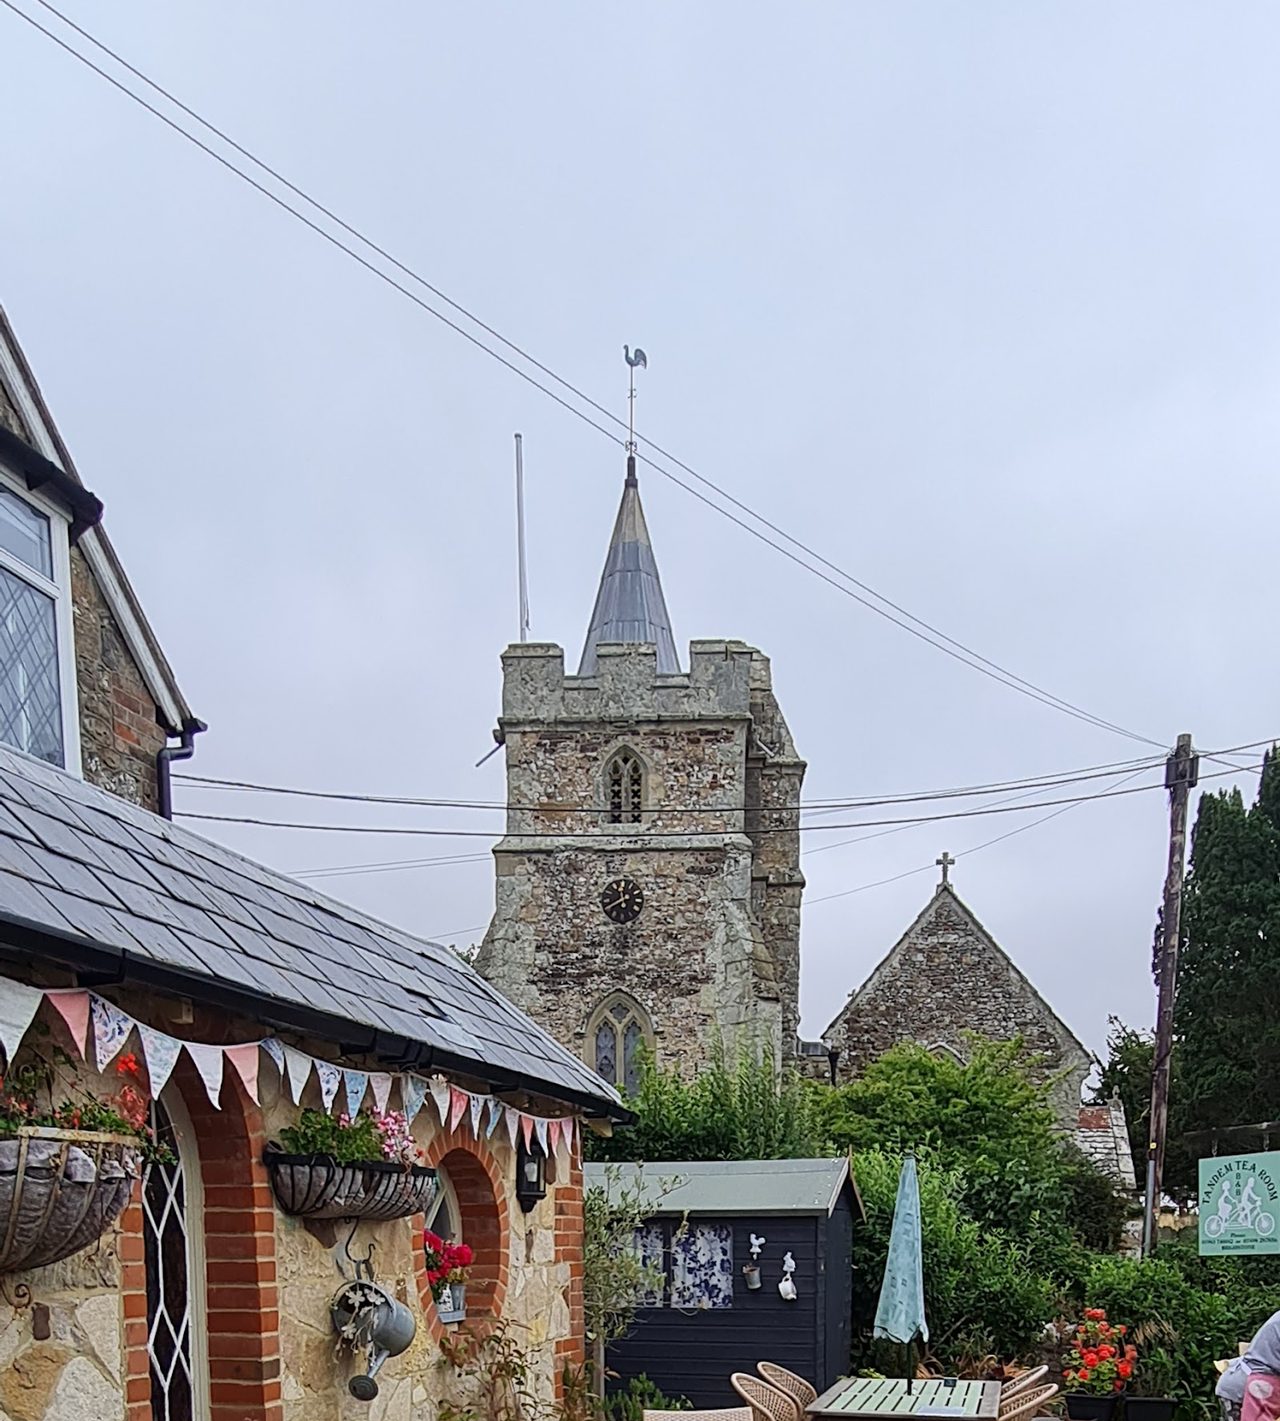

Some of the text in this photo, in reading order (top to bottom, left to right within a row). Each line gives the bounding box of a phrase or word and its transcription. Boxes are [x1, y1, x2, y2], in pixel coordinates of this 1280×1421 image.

[1202, 1161, 1278, 1204] TANDEM TEA ROOM
